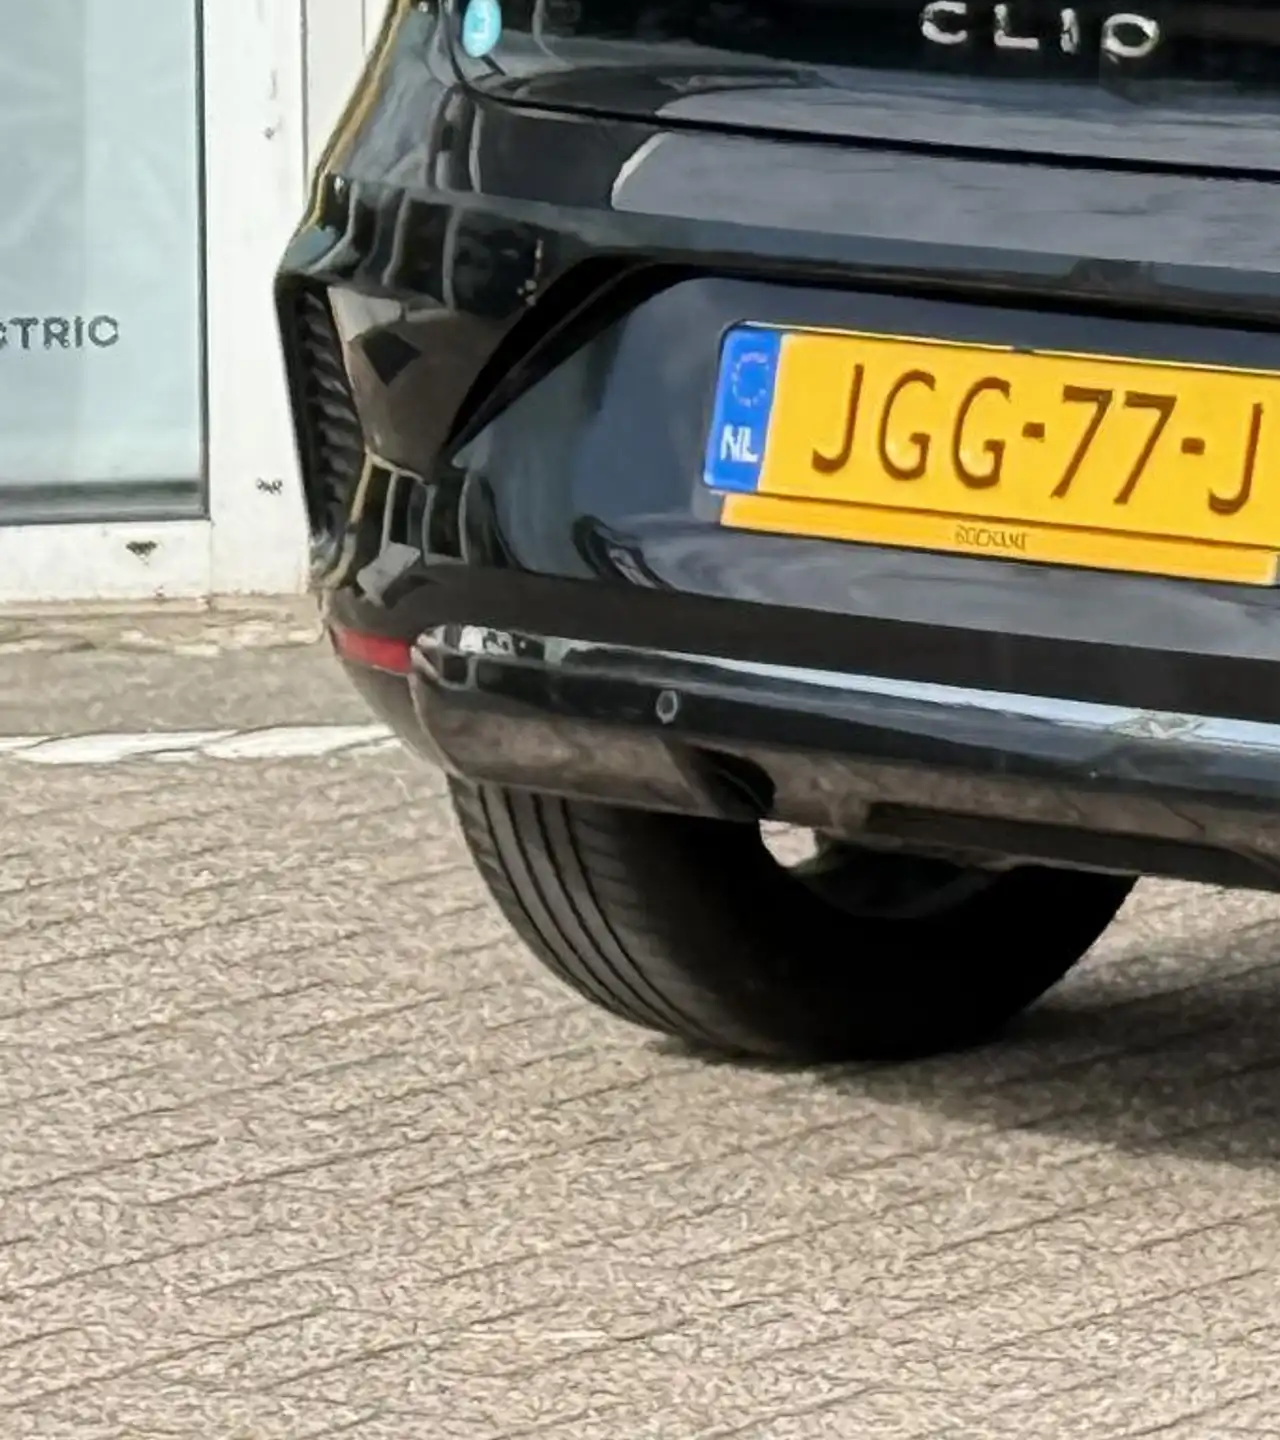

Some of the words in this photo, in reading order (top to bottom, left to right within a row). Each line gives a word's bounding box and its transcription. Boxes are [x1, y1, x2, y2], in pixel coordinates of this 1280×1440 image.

[920, 0, 1160, 58] CLIO
[0, 315, 119, 349] TRIC
[720, 423, 759, 463] NL
[811, 363, 1264, 515] JGG-77-J
